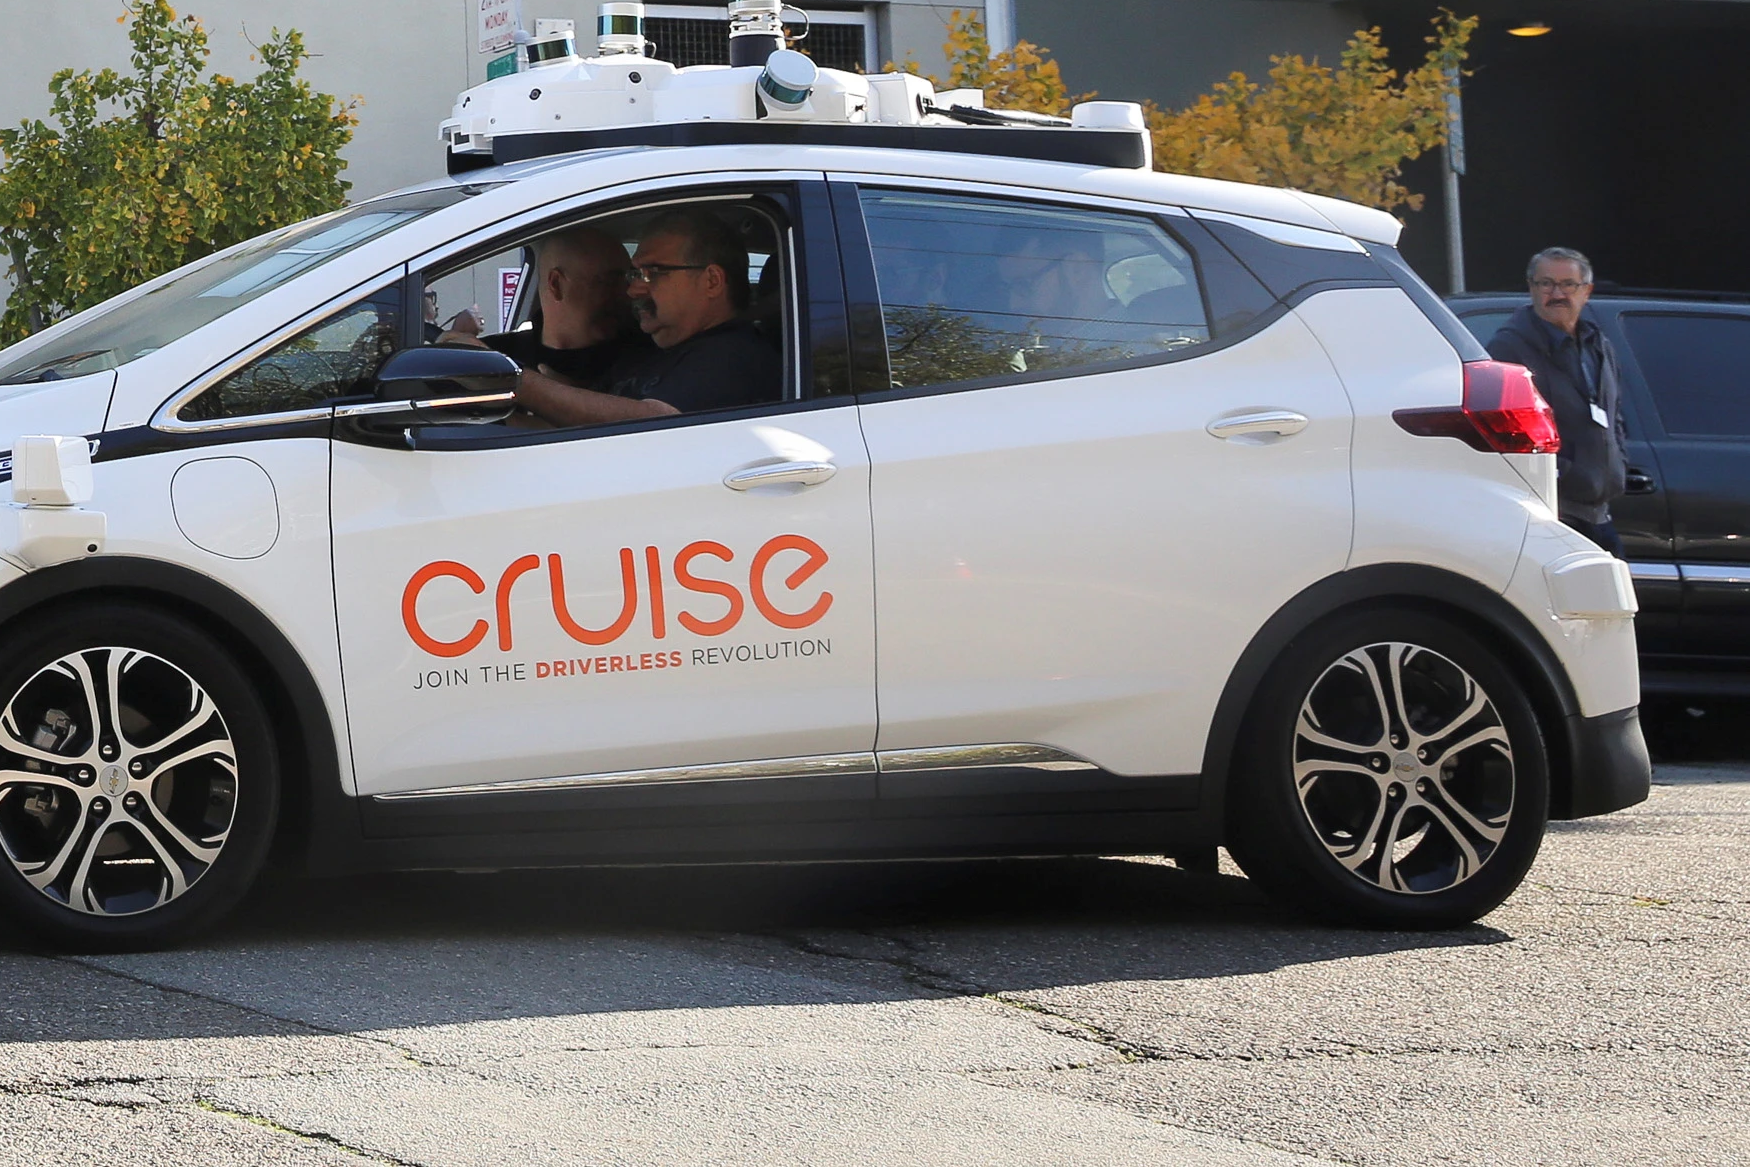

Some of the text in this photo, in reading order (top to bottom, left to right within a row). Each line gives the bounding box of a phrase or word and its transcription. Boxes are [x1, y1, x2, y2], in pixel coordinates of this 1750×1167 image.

[485, 10, 508, 30] MONDAY
[413, 638, 832, 690] JOIN THE DRIVERLESS REVOLUTION
